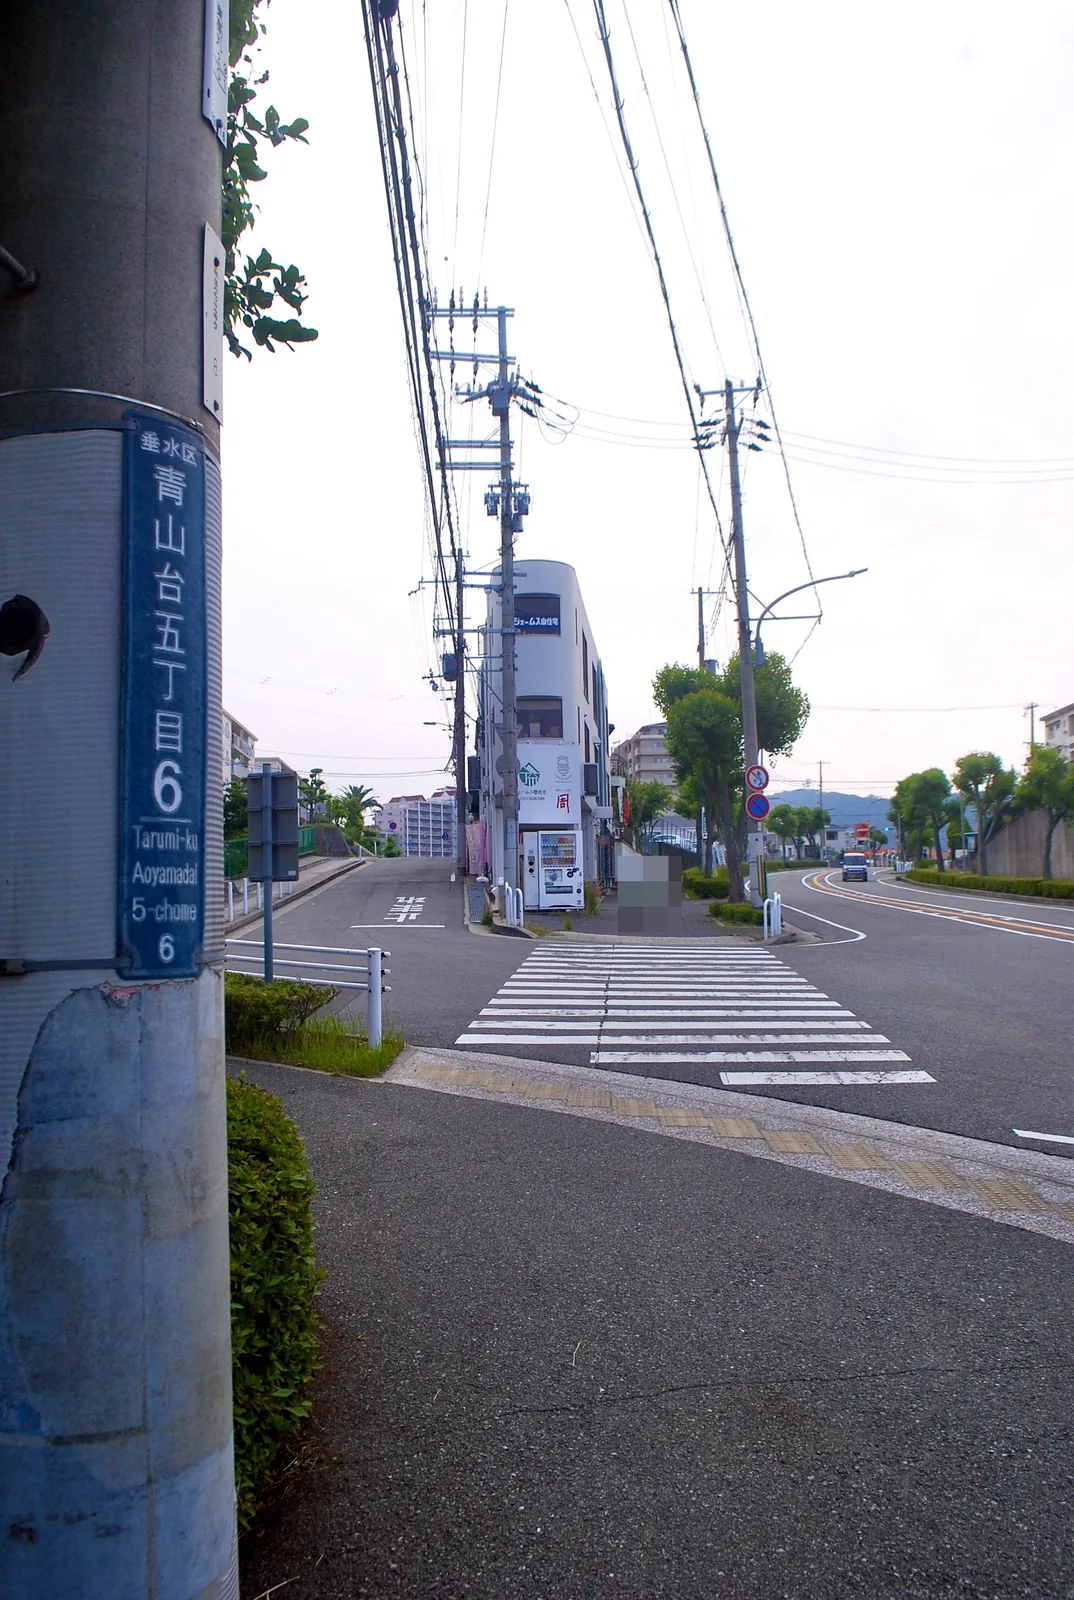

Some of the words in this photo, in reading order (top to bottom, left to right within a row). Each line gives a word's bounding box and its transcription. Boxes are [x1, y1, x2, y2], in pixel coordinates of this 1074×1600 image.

[140, 430, 198, 468] 垂水区
[131, 824, 199, 851] Tarumi-ku
[131, 860, 198, 887] Aoyamadai
[131, 896, 198, 922] 5-chome
[383, 896, 427, 923] 止まれ
[158, 932, 175, 963] 6
